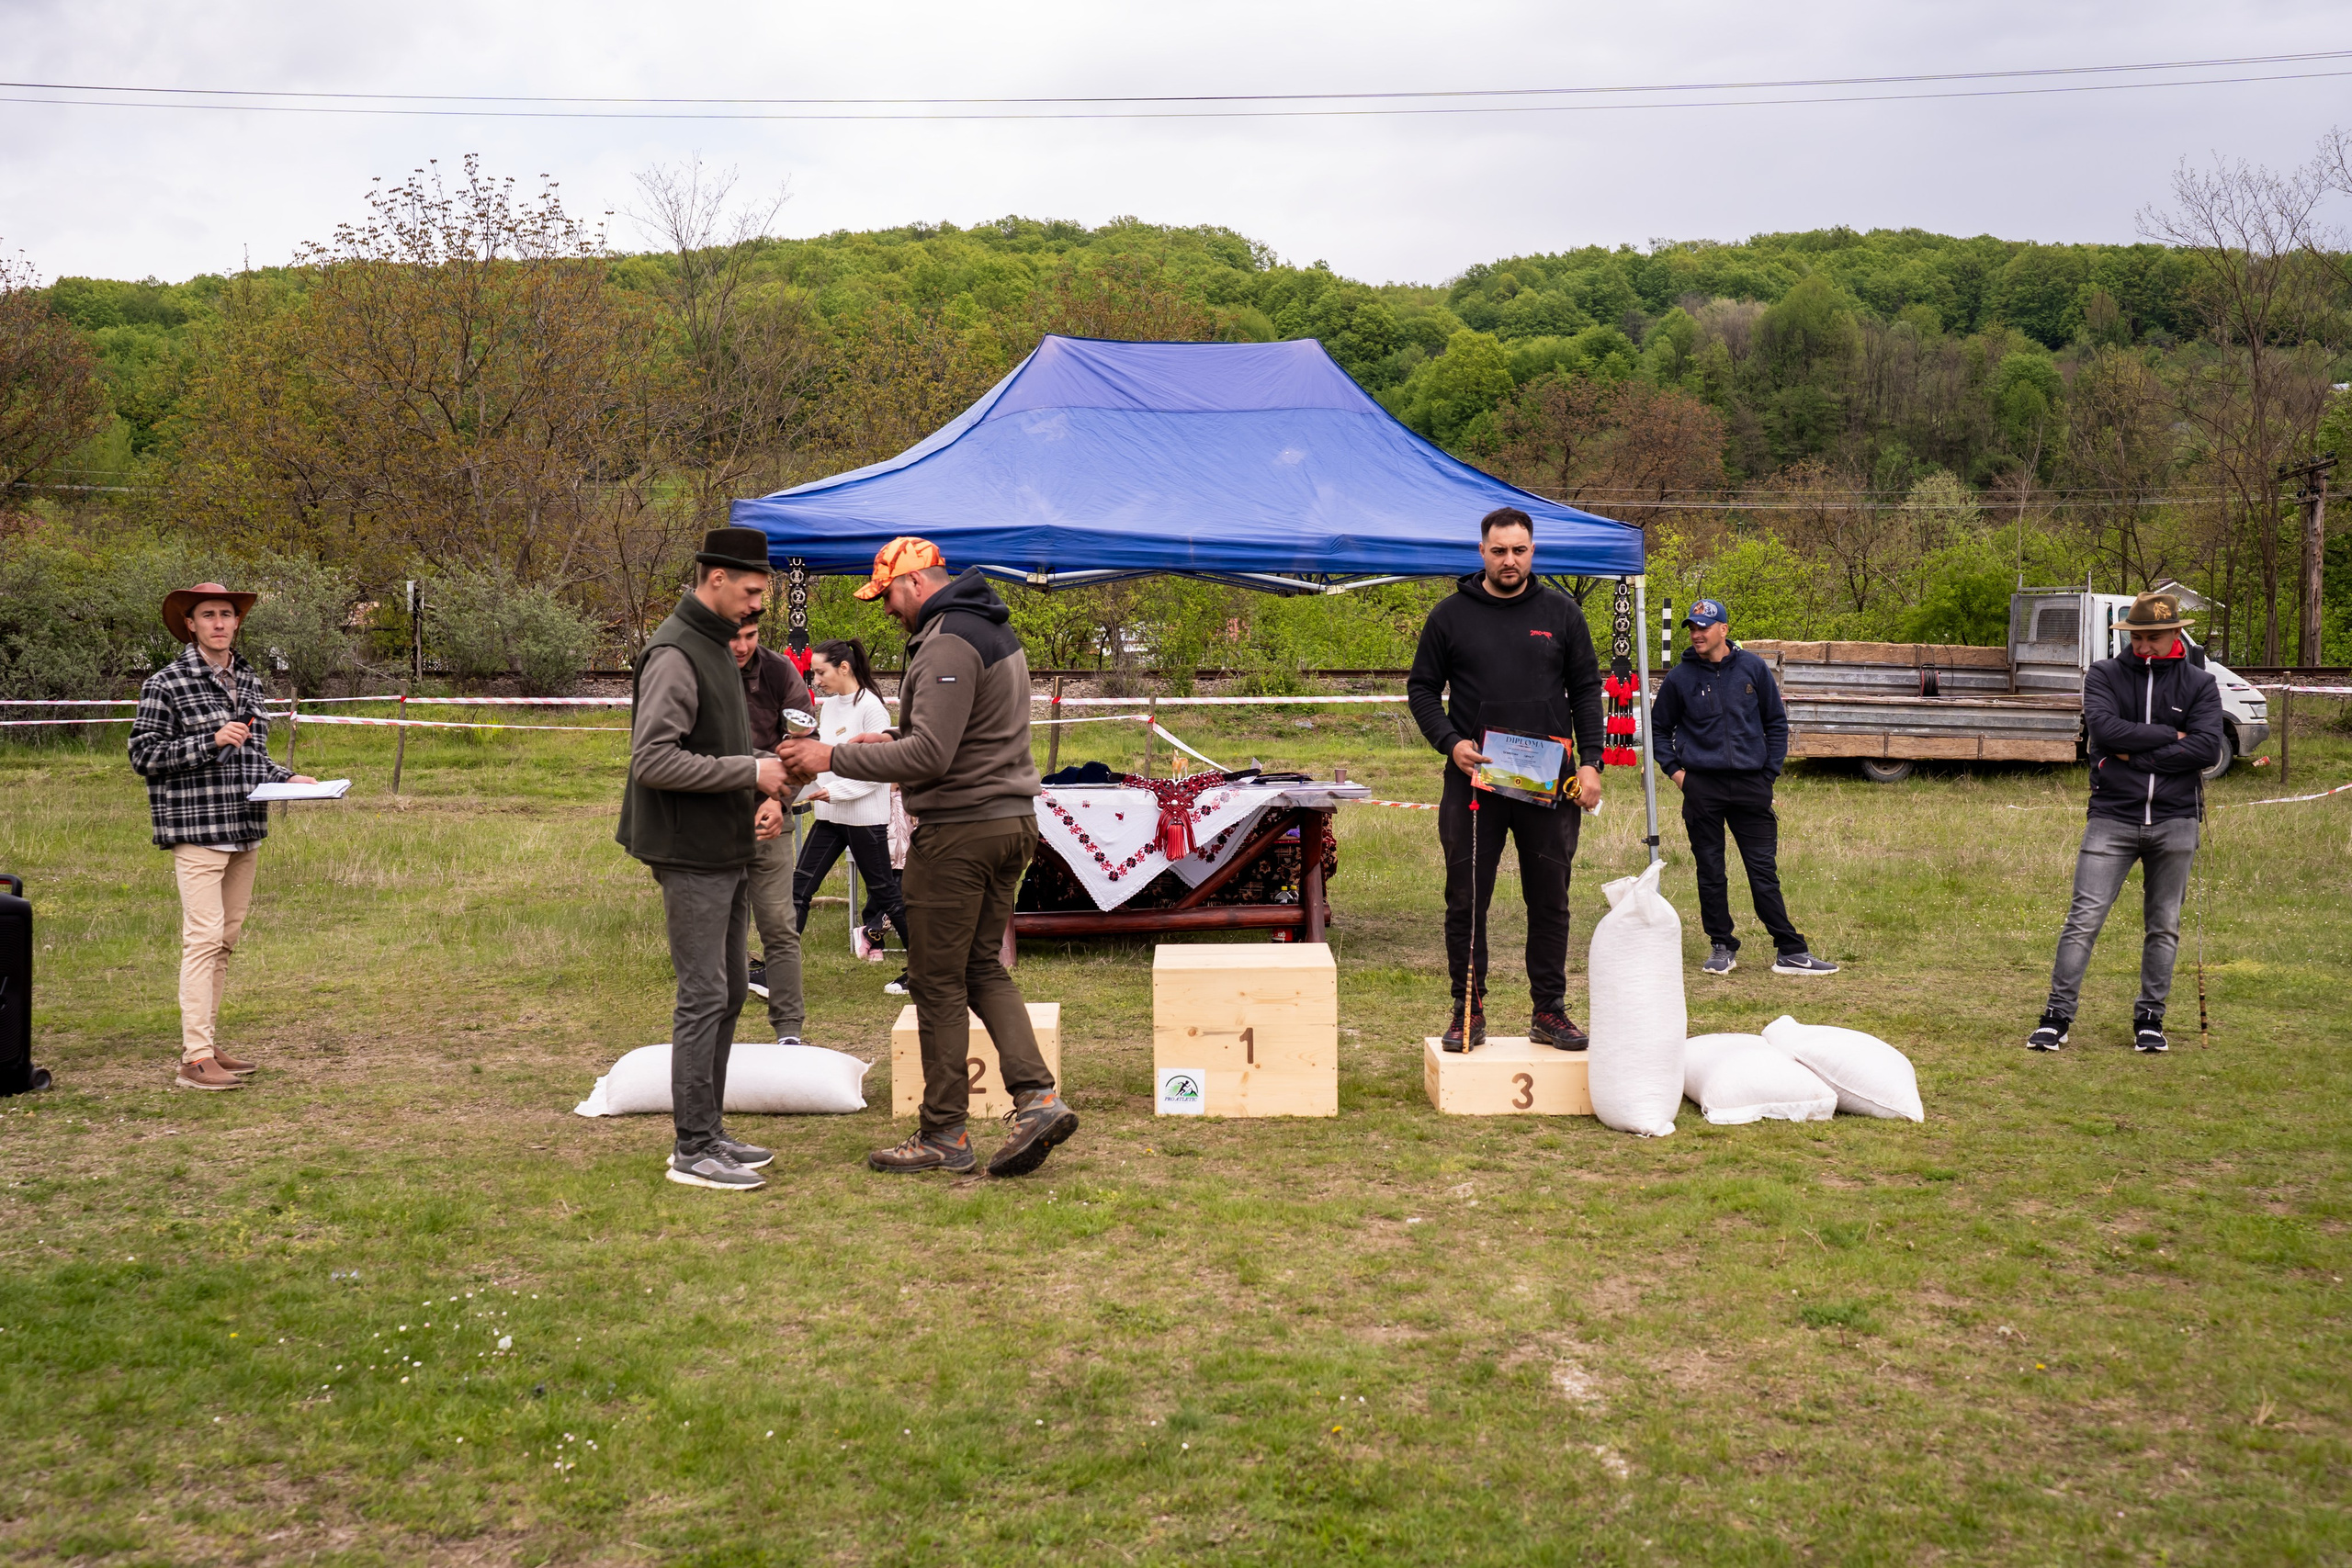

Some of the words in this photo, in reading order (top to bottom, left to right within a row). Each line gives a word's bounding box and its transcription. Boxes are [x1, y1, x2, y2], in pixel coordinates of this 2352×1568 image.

[1239, 1027, 1254, 1065] 1
[967, 1057, 987, 1094] 2
[1511, 1072, 1533, 1110] 3
